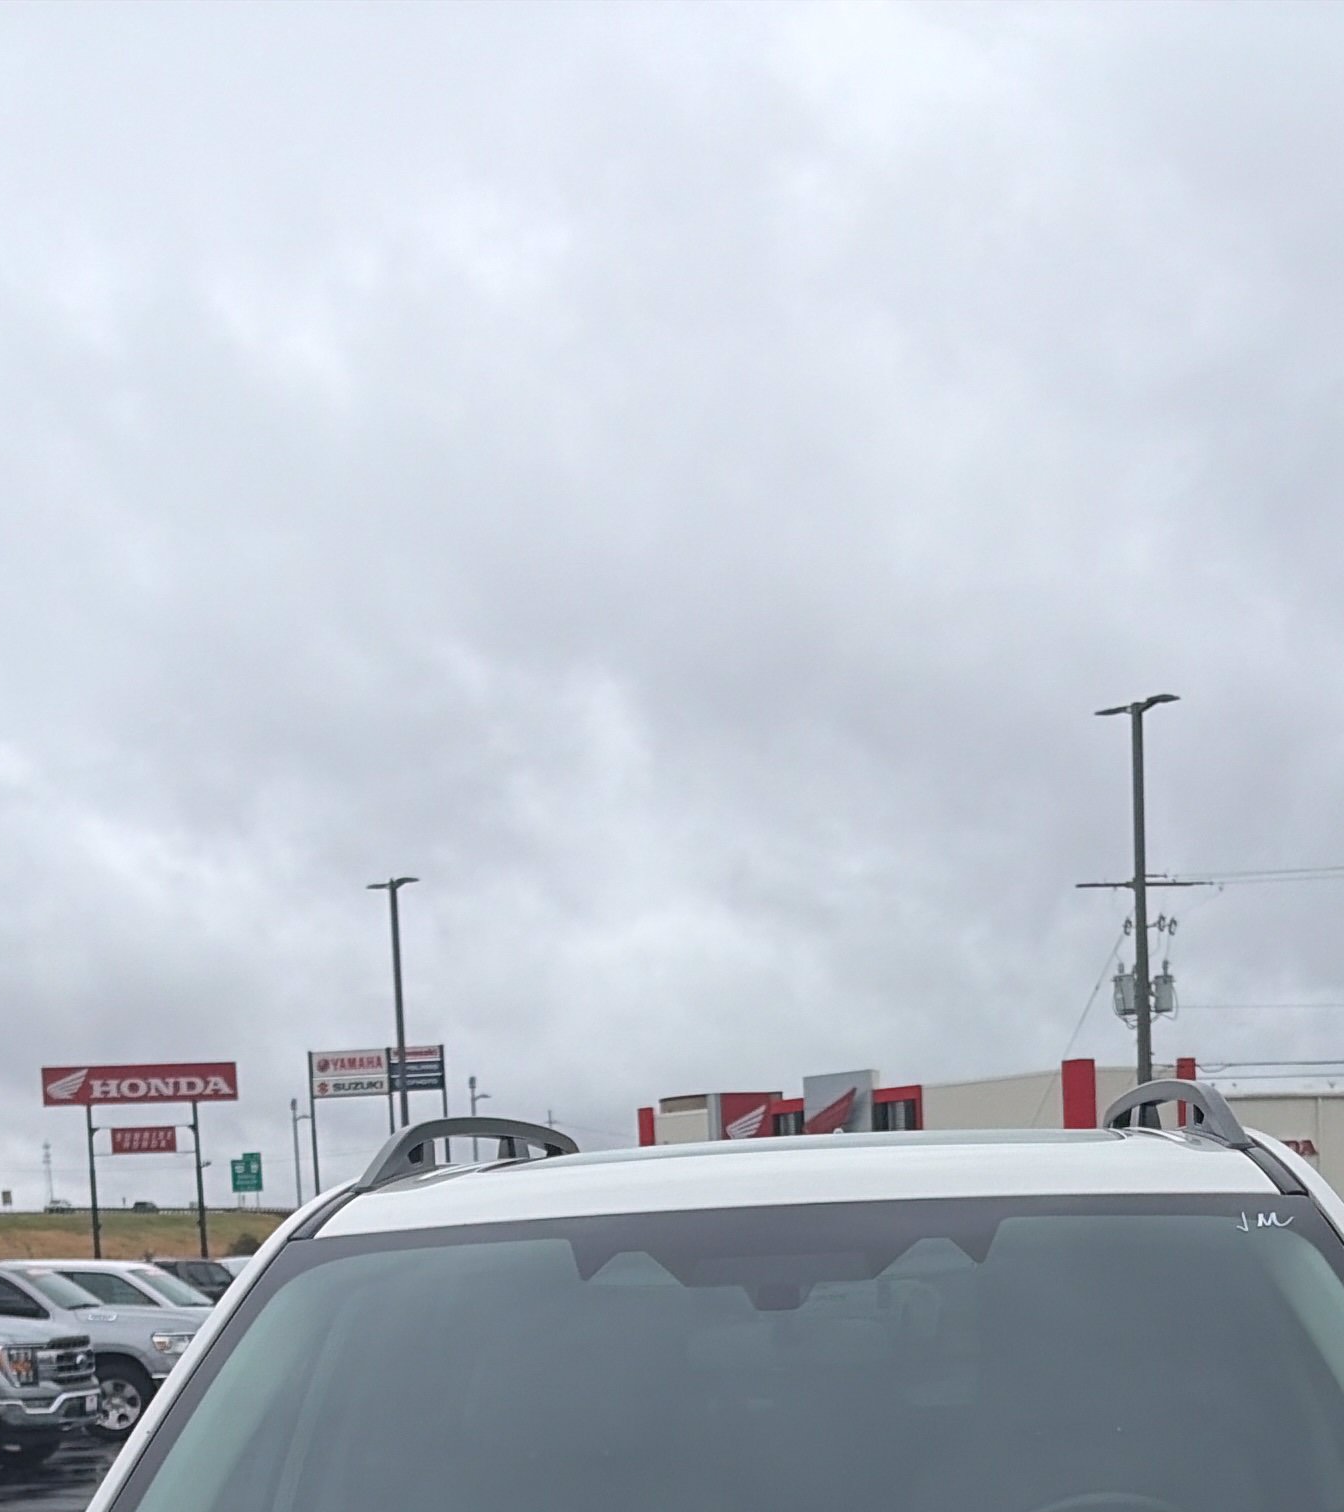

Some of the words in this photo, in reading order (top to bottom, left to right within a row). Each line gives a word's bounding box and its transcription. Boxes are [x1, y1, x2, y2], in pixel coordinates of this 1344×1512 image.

[332, 1055, 383, 1071] YAMAHA
[89, 1076, 234, 1099] HONDA
[333, 1081, 384, 1092] SUZUKI
